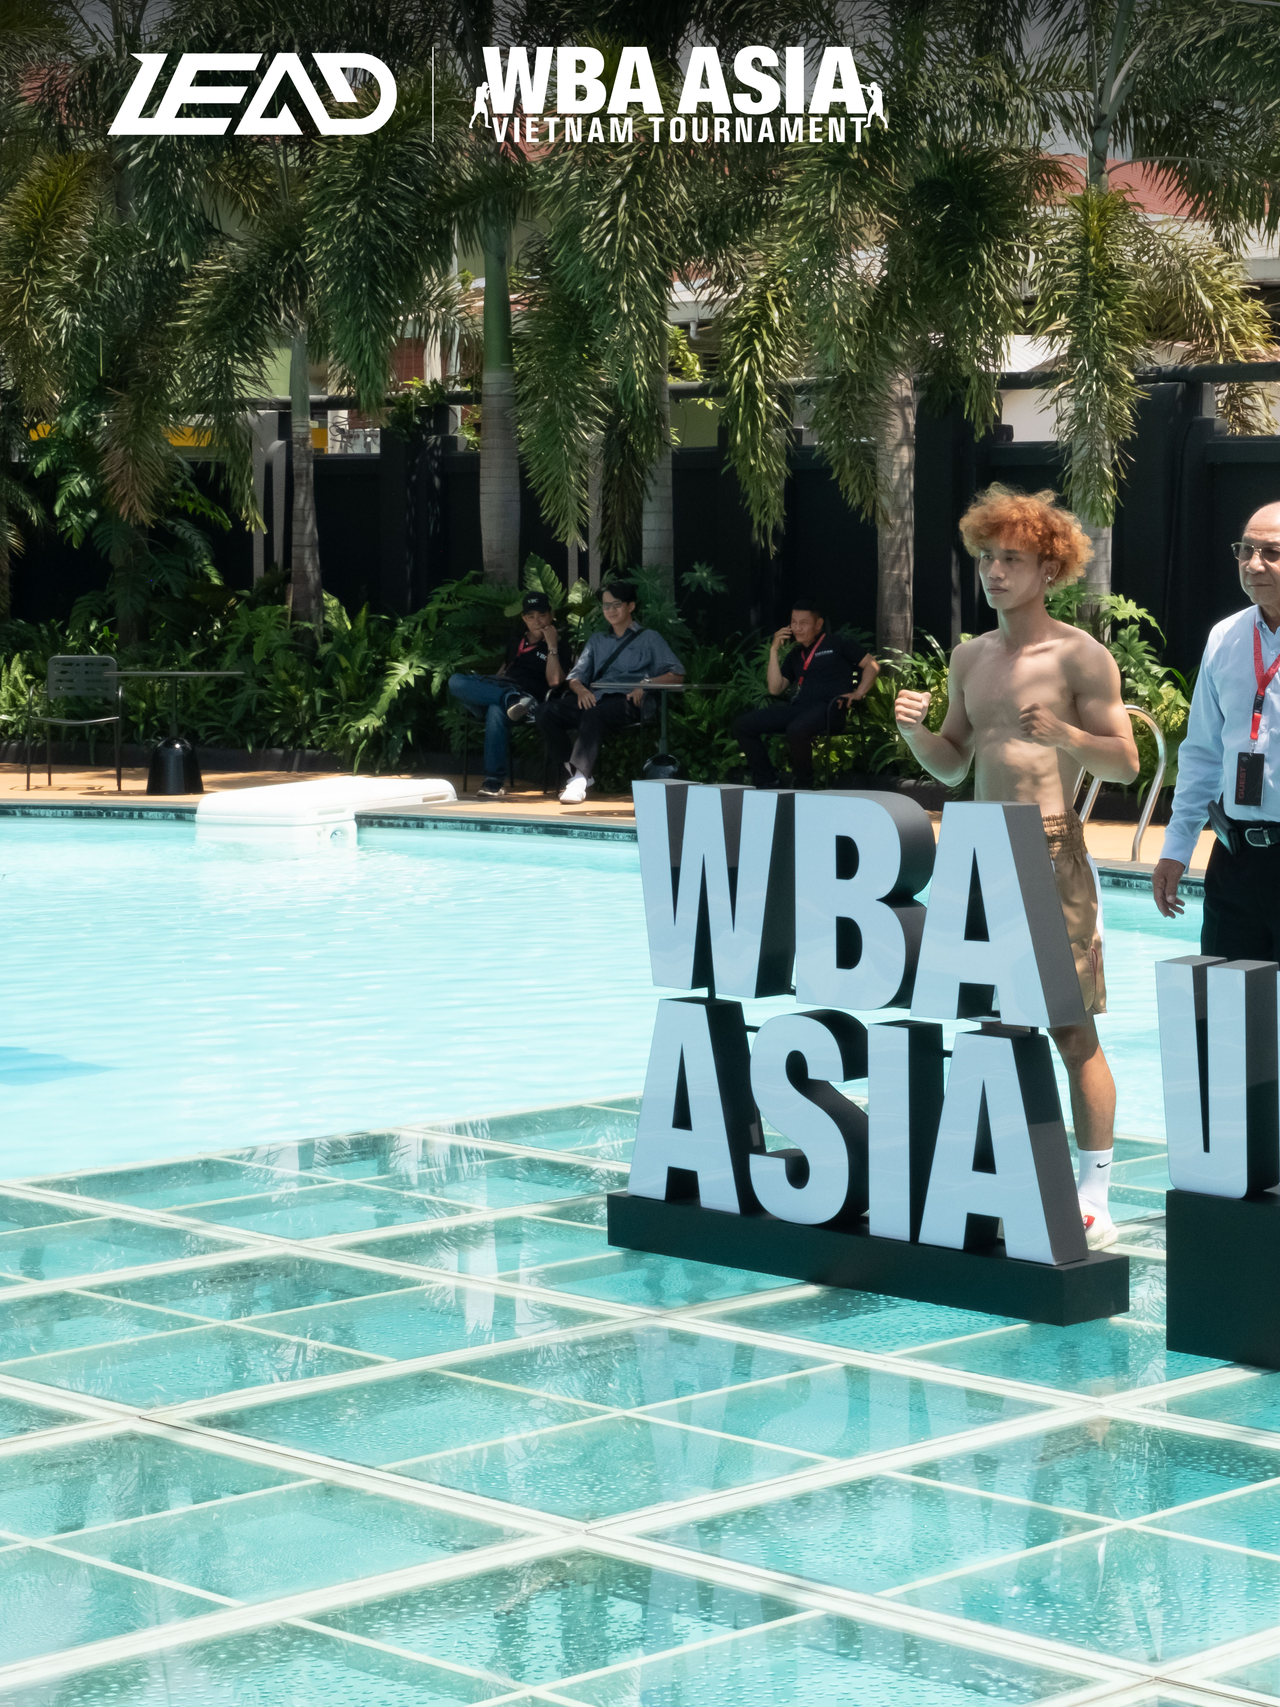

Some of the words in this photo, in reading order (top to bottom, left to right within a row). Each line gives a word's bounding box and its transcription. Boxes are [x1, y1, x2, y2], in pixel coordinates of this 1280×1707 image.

[632, 779, 1053, 1028] WBA
[1238, 767, 1247, 799] GUEST
[628, 998, 1060, 1266] ASIA
